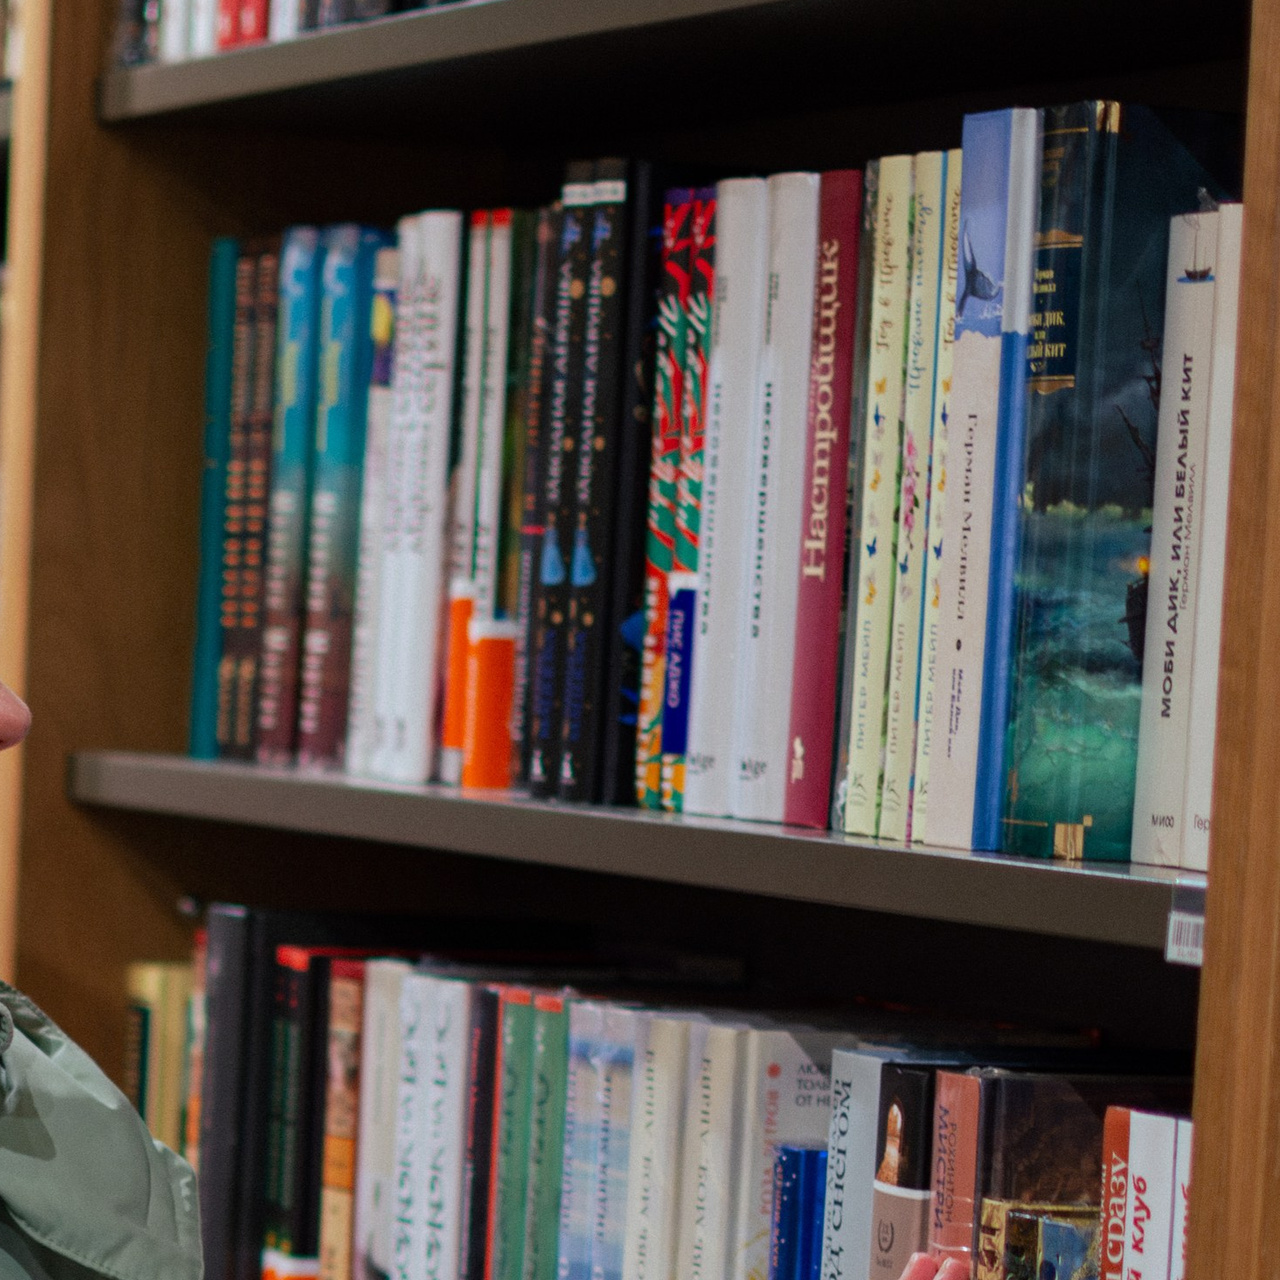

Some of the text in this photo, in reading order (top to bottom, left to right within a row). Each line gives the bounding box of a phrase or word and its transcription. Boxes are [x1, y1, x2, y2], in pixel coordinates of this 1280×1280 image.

[802, 237, 841, 582] Настройщик
[962, 413, 980, 505] Герман
[1159, 352, 1194, 720] МОБИ ДИК, ИЛИ БЕЛЫЙ КИТ
[1178, 461, 1197, 611] Герман Мелвилл
[855, 684, 868, 750] ПИТЕР
[889, 688, 902, 754] ПИТЕР
[922, 689, 935, 756] ПИТЕР
[1193, 813, 1210, 834] Гер
[831, 1079, 852, 1232] СНЕГОМ
[933, 1103, 951, 1230] МИСТРИ
[944, 1122, 958, 1224] РОХИНТОН
[1107, 1150, 1129, 1258] сразу
[1130, 1173, 1152, 1254] клуб
